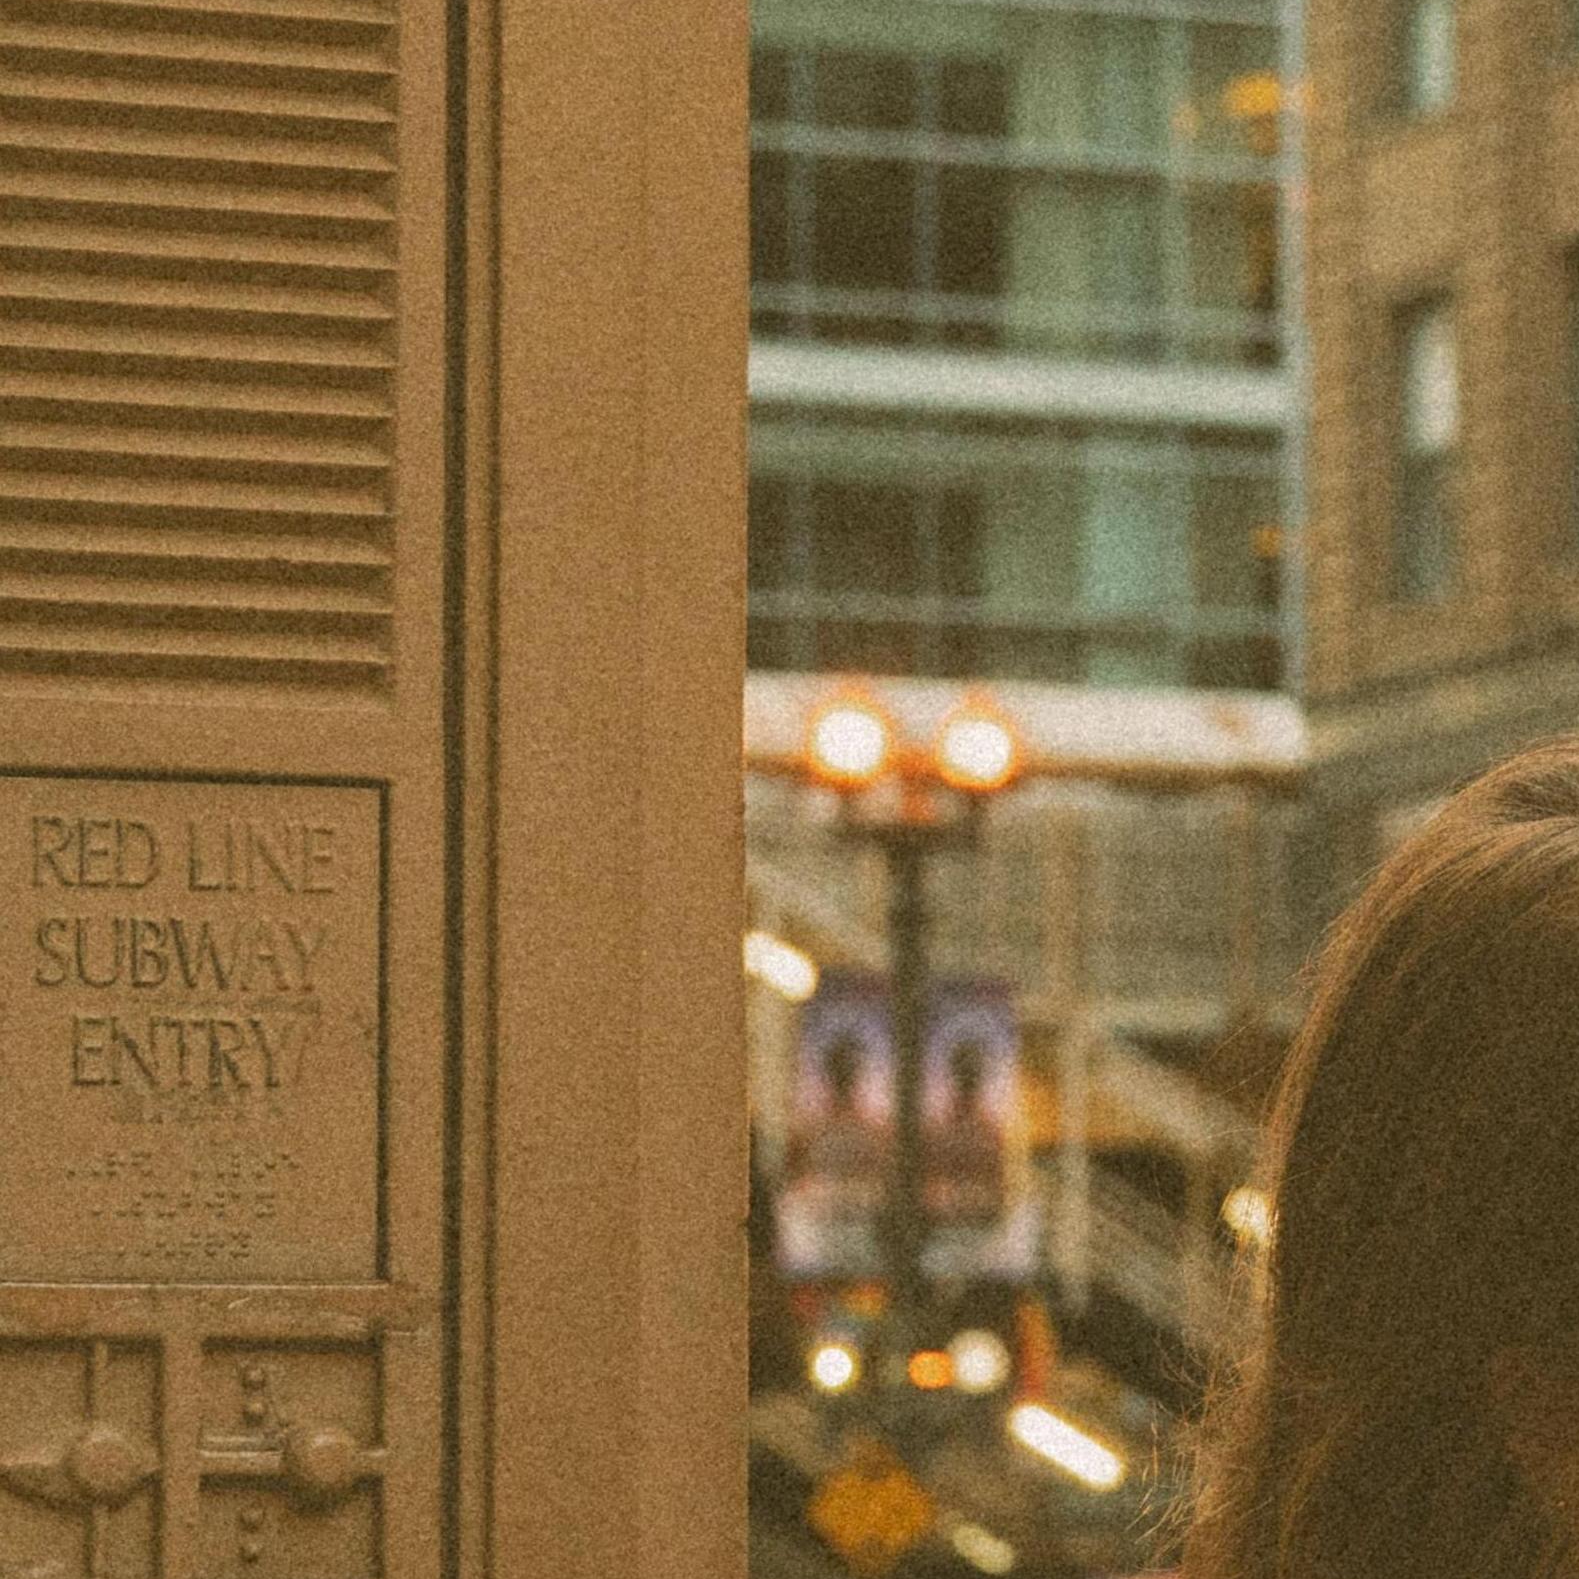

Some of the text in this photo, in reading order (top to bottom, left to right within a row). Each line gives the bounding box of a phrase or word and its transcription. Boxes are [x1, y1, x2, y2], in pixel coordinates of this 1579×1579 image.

[29, 814, 337, 896] RED LINE
[32, 915, 329, 994] SUBWAY
[70, 1016, 292, 1090] ENTRY
